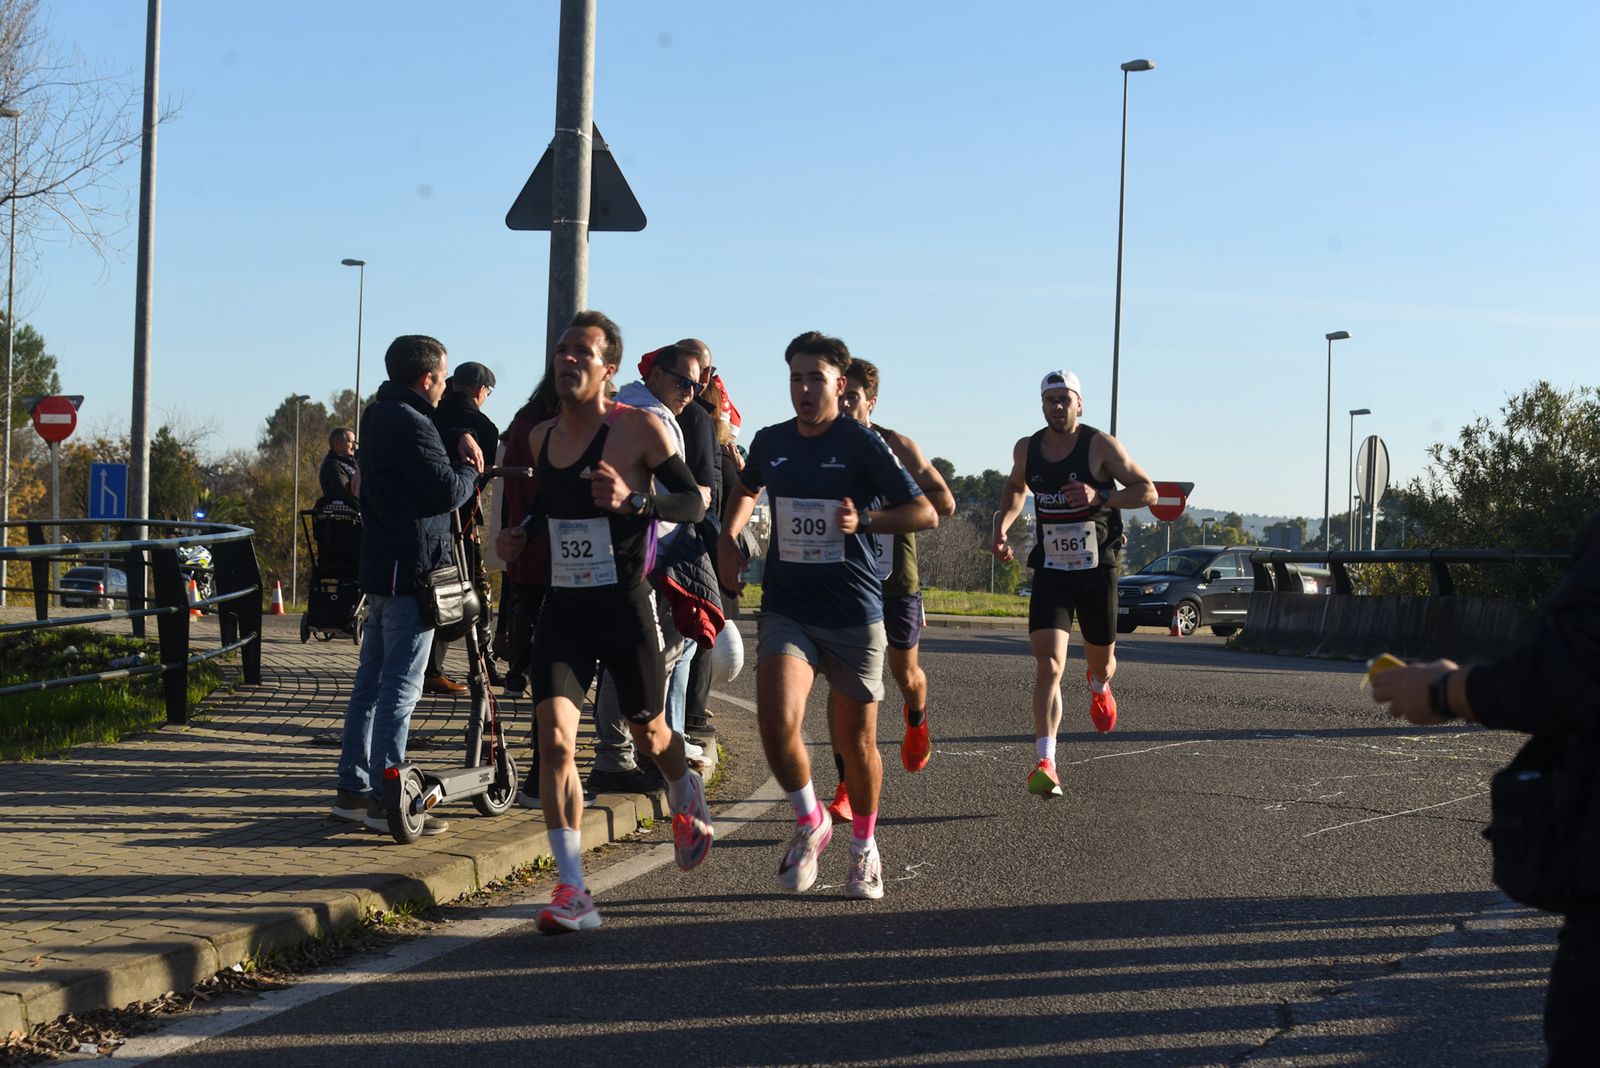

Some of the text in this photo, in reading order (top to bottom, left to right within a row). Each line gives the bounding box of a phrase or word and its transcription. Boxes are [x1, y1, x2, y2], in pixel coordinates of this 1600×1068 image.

[791, 517, 826, 536] 309
[561, 540, 594, 558] 532
[1052, 536, 1086, 552] 1561
